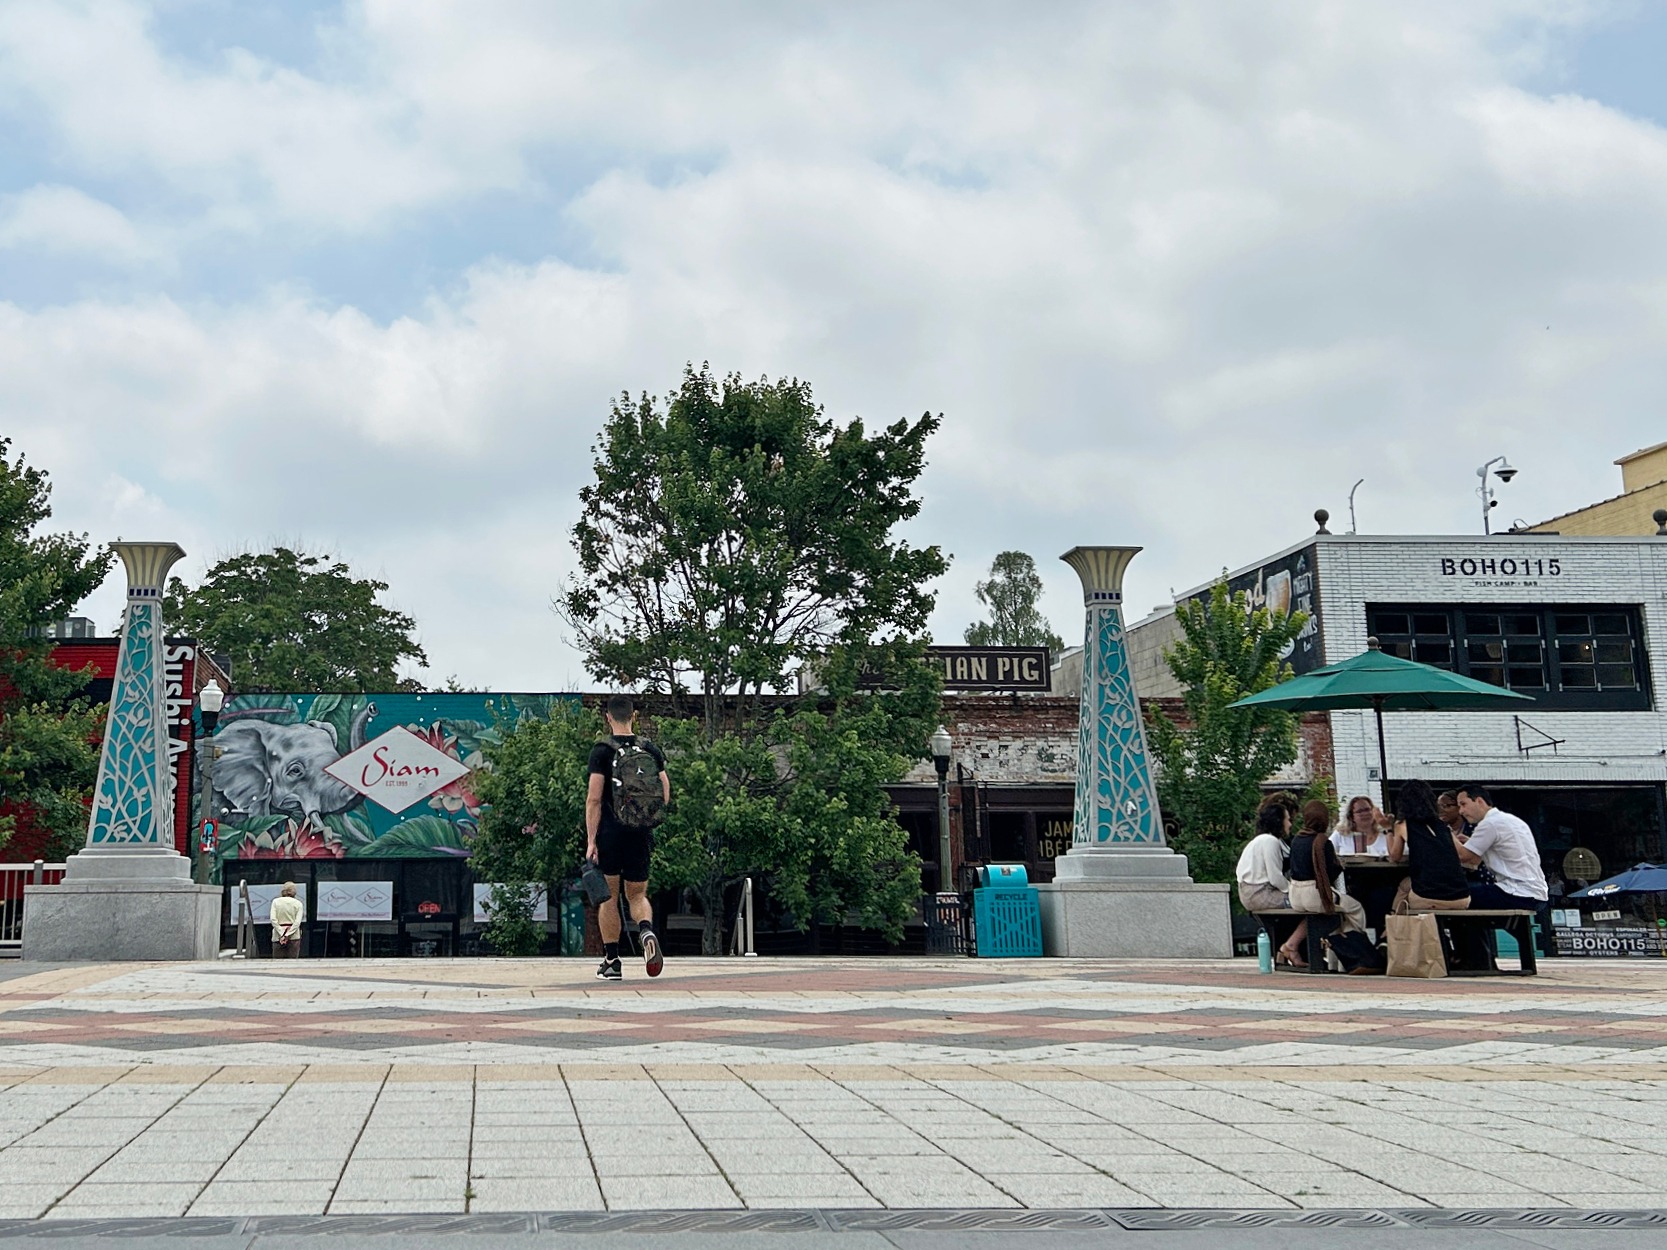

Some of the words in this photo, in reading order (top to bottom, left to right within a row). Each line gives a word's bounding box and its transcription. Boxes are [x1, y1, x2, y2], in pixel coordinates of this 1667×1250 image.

[1441, 558, 1561, 576] BOHO115
[997, 657, 1040, 682] PIG
[164, 645, 194, 726] Sushi
[361, 746, 439, 788] Siam
[995, 893, 1028, 901] RECYCLE
[418, 903, 441, 914] OPEN
[1572, 937, 1646, 950] BOHO115
